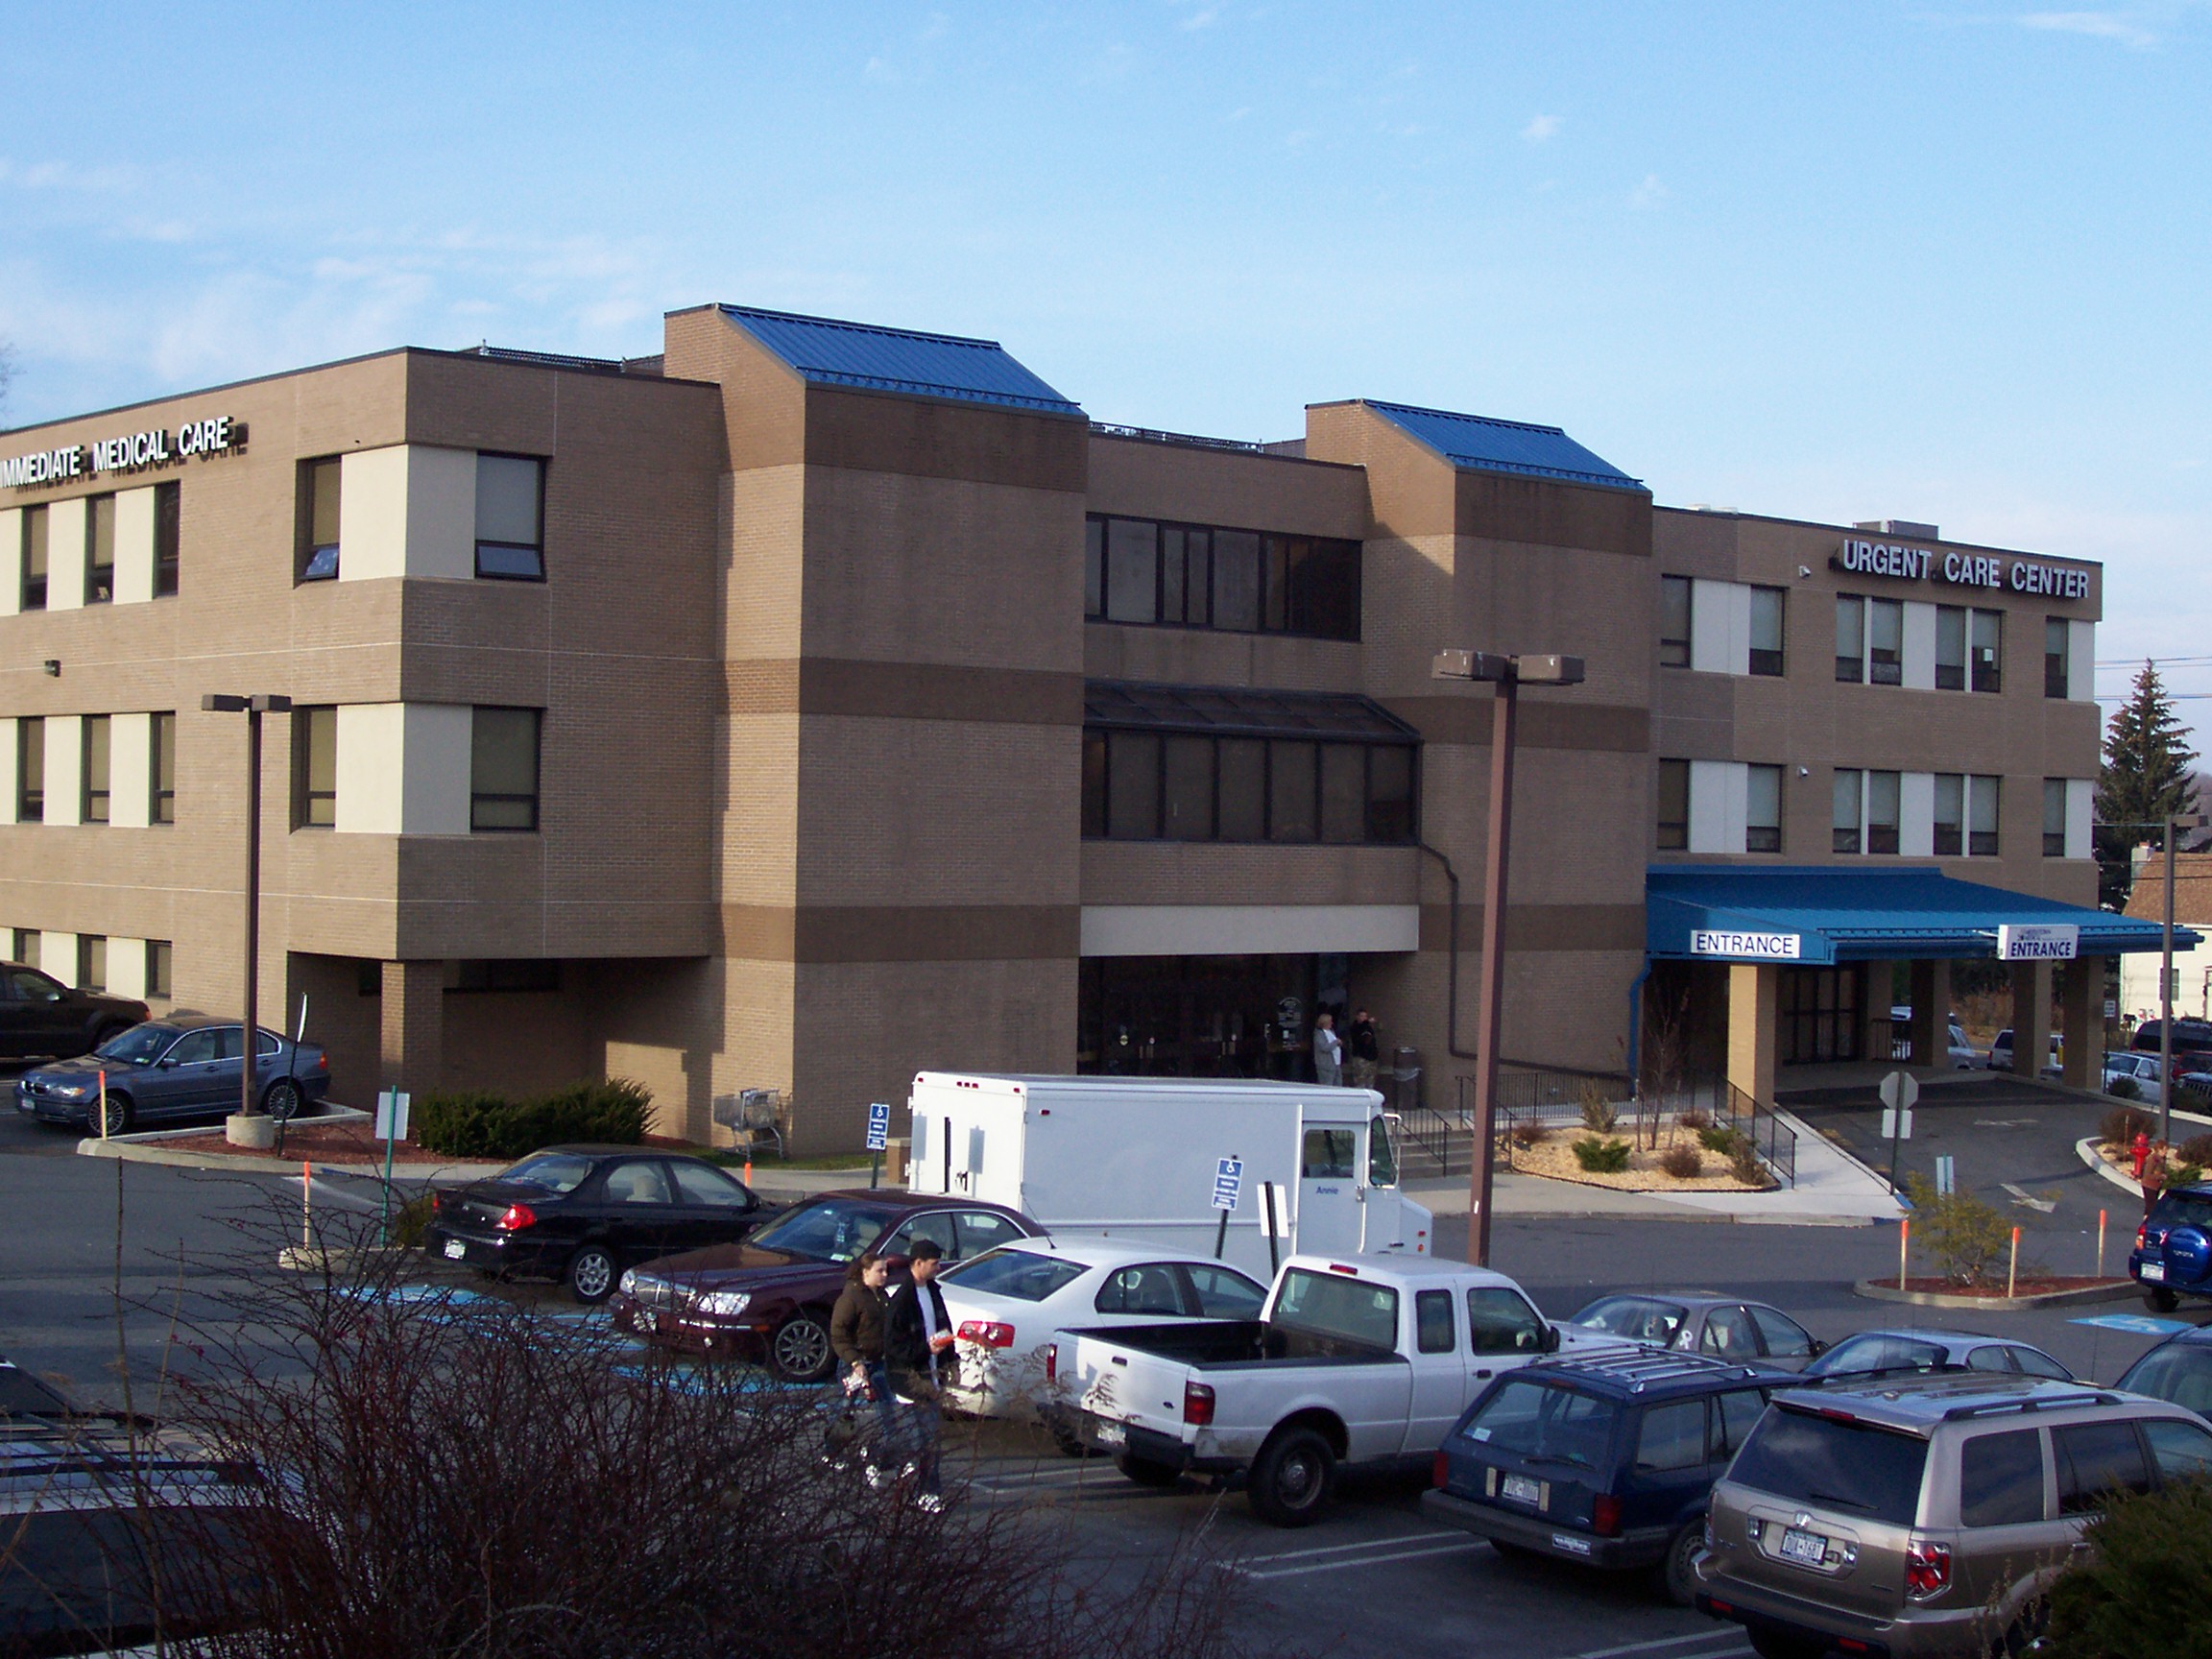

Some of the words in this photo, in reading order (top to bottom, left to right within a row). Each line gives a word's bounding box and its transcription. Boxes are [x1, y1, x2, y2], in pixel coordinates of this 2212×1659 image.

[93, 429, 169, 472] MEDICAL
[178, 416, 229, 456] CARE
[1843, 540, 1933, 579] URGENT
[1944, 552, 2001, 589] CARE
[2010, 563, 2089, 599] CENTER
[1696, 933, 1793, 954] ENTRANCE
[2010, 941, 2072, 957] ENTRANCE
